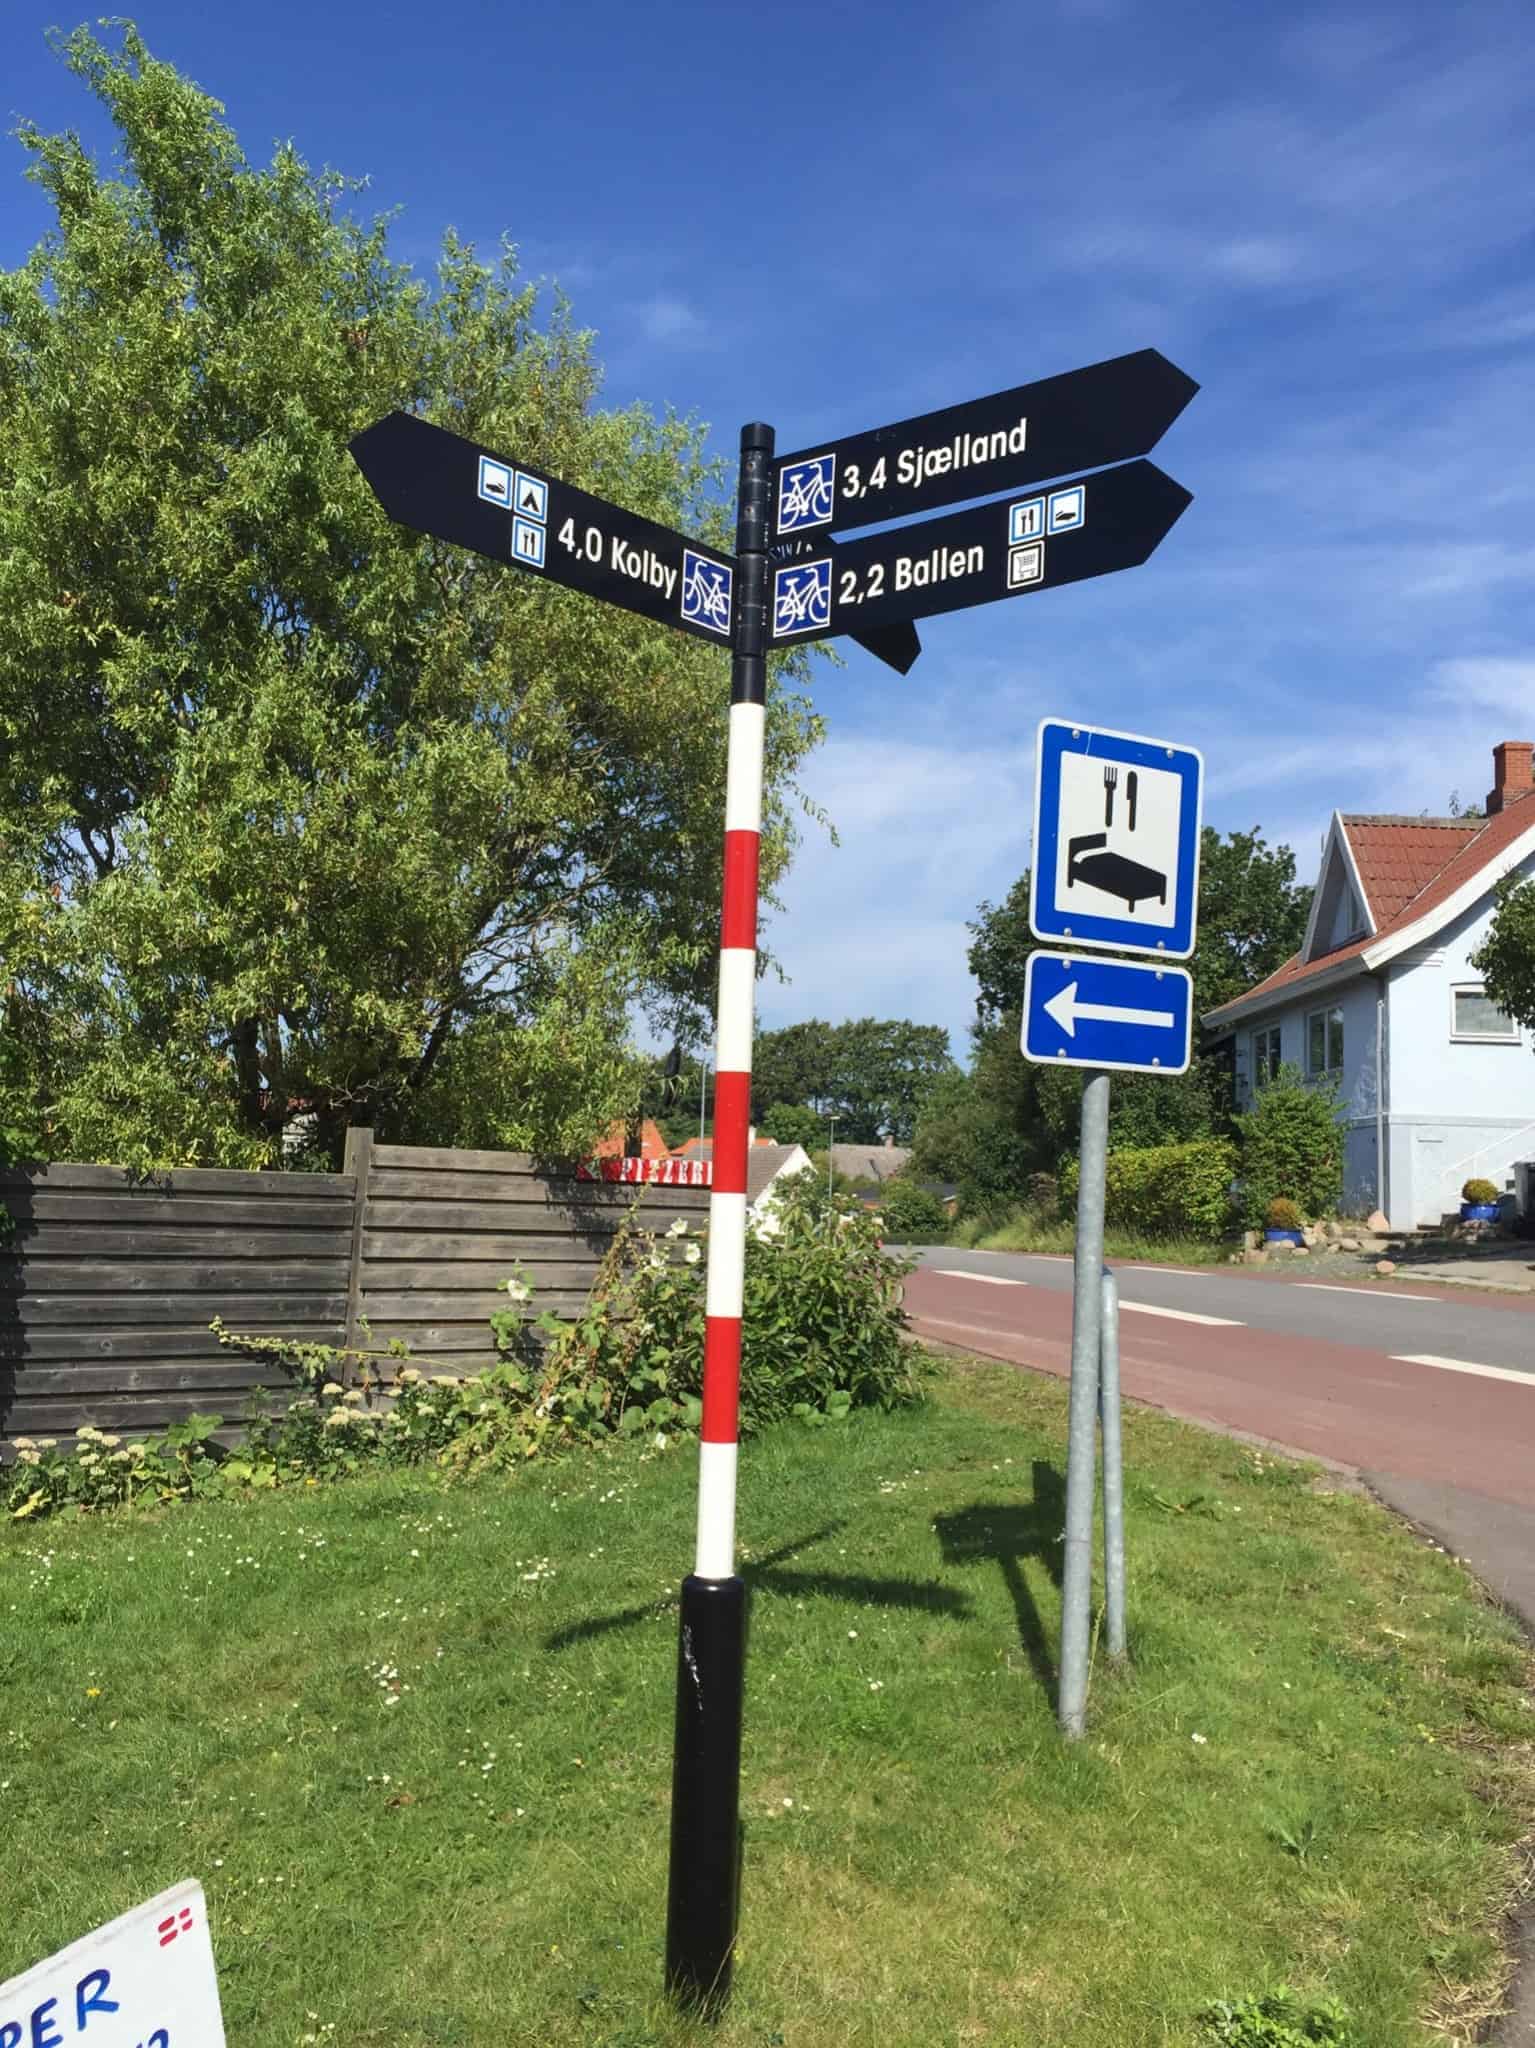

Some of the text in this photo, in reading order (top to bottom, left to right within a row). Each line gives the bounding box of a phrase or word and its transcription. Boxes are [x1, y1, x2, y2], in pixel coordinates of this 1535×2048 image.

[842, 417, 1027, 498] 3,4 Sjælland
[558, 518, 677, 599] 4,0 Kolby
[838, 544, 984, 605] 2,2 Ballen
[620, 1157, 712, 1184] PIZZERI
